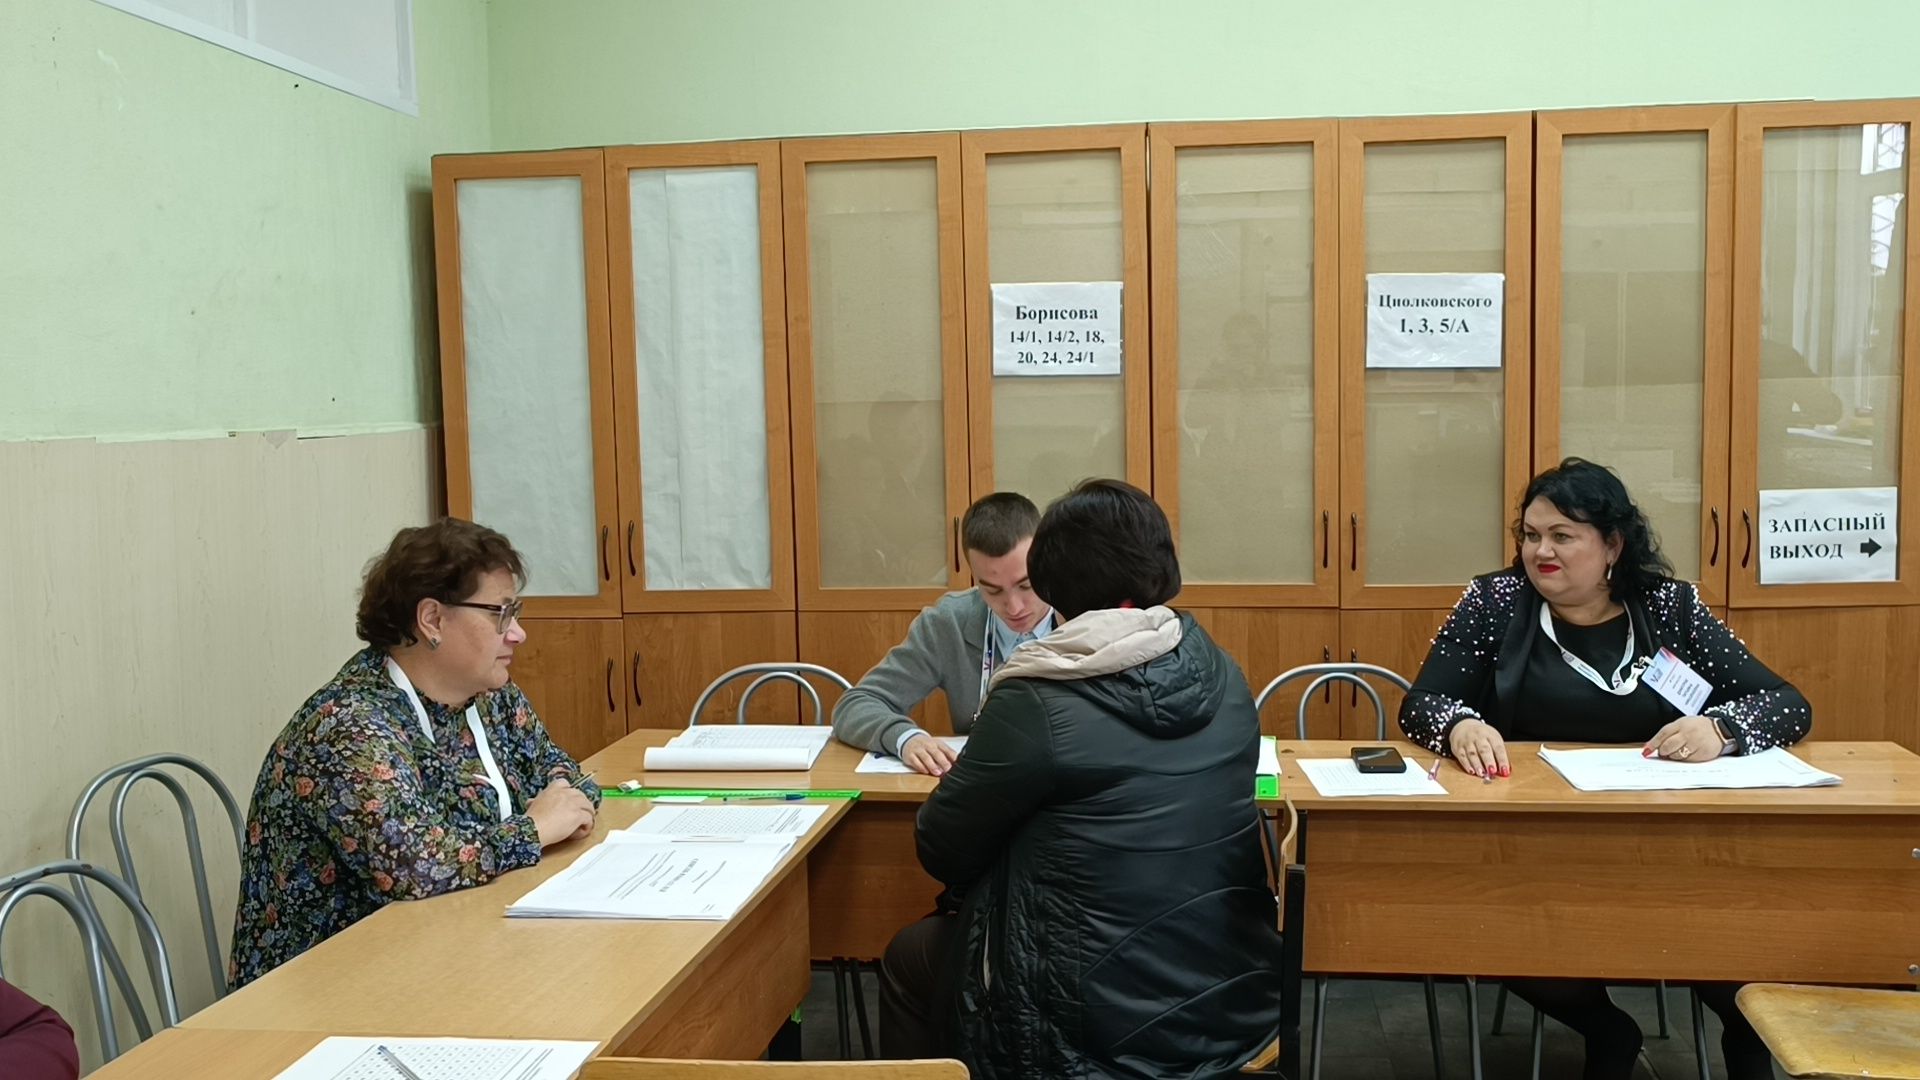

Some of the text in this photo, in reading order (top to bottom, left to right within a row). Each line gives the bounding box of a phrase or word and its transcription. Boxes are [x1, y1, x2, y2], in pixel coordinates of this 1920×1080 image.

[1379, 294, 1492, 309] Циолковского
[1015, 306, 1098, 324] Борисова
[1400, 318, 1470, 335] 1, 3, 5/А
[1010, 330, 1105, 344] 14/1, 14/2, 18,
[1017, 351, 1094, 365] 20, 24, 24/1
[1768, 512, 1886, 533] ЗАПАСНЫЙ
[1770, 543, 1844, 559] ВЫХОД
